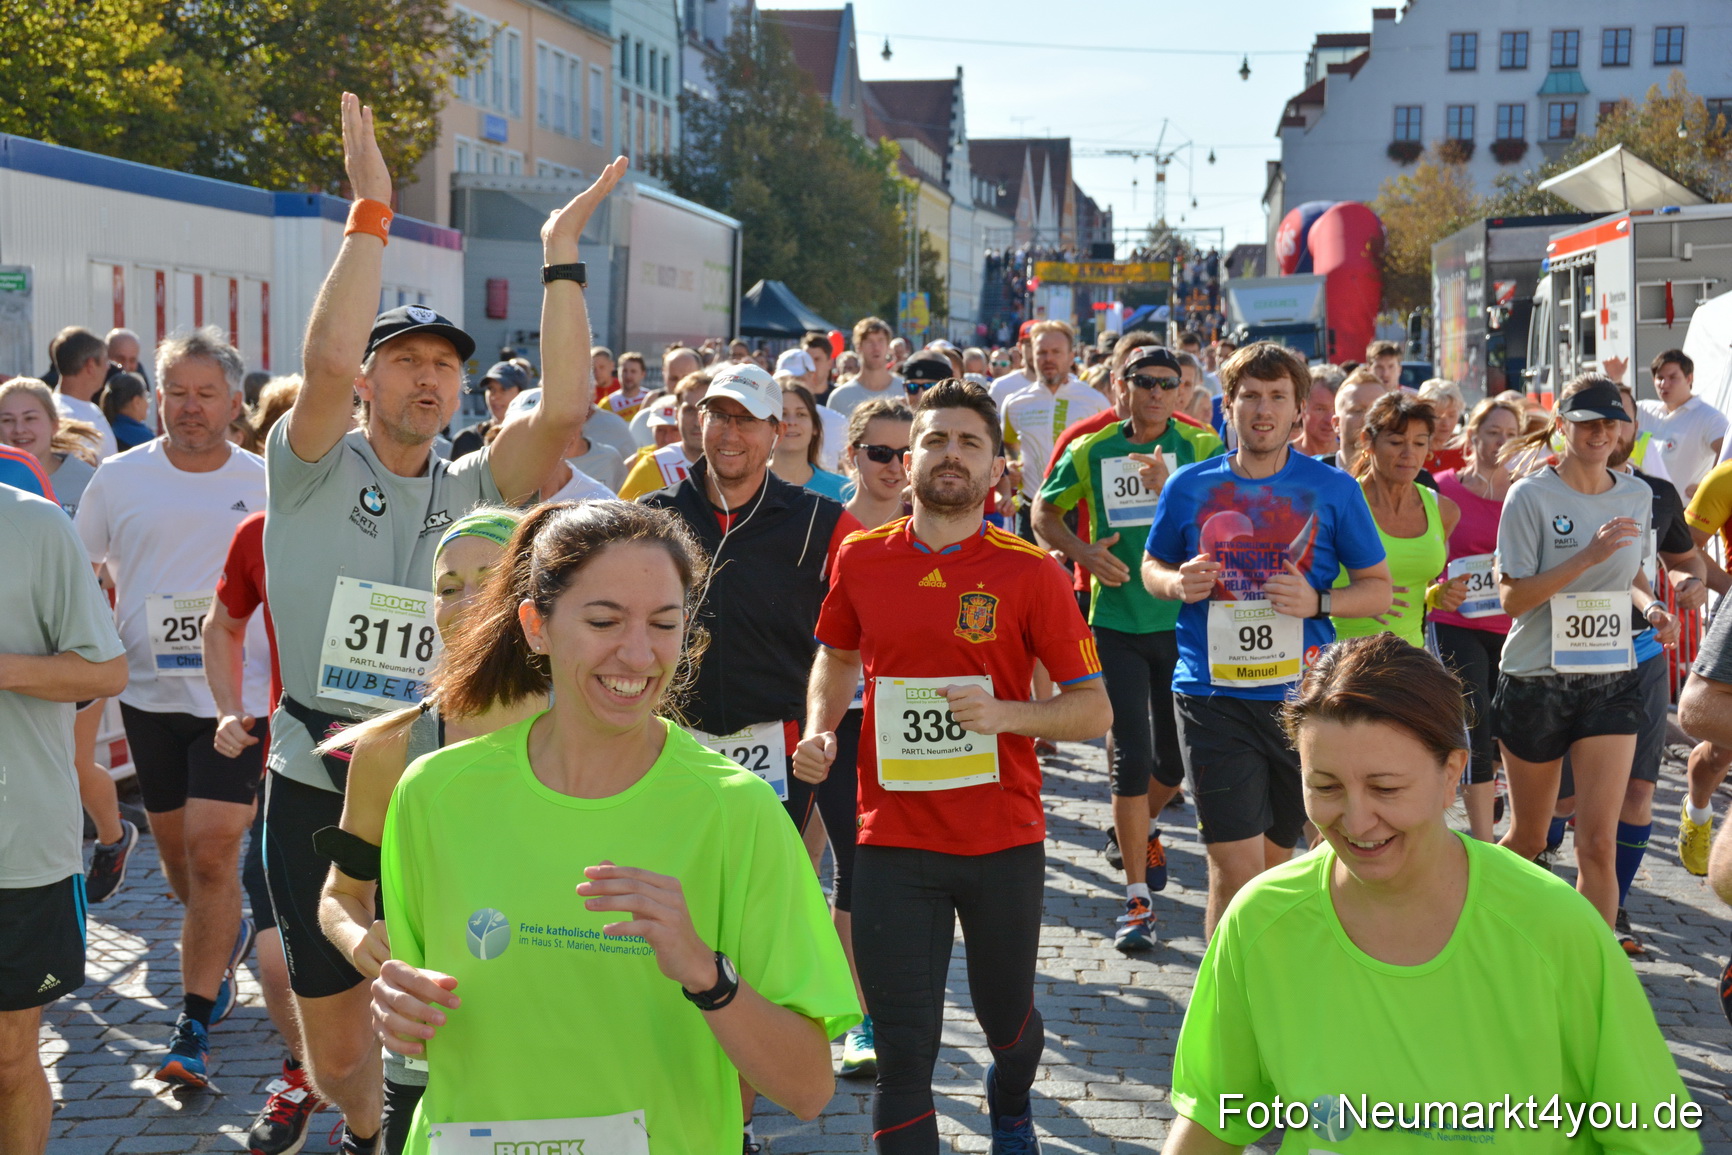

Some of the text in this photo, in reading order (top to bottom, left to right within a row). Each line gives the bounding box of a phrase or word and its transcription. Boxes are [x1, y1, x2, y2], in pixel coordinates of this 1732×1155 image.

[918, 580, 947, 588] adidas
[370, 592, 427, 614] BOCK
[1576, 599, 1611, 609] BOCK
[1234, 607, 1276, 619] BOCK
[1565, 613, 1621, 639] 3029
[345, 614, 435, 662] 3118
[1239, 625, 1274, 652] 98
[350, 656, 415, 675] PARTL Neumarkt
[1249, 653, 1278, 661] Neumarkt
[1236, 665, 1278, 678] Manuel
[903, 709, 967, 743] 338
[719, 745, 770, 772] 22
[901, 745, 962, 756] PARTL Neumarkt
[519, 922, 544, 935] Freie
[545, 924, 600, 940] katholische
[518, 934, 529, 945] im
[531, 937, 552, 948] Haus
[554, 938, 565, 949] St.
[566, 940, 597, 952] Marien,
